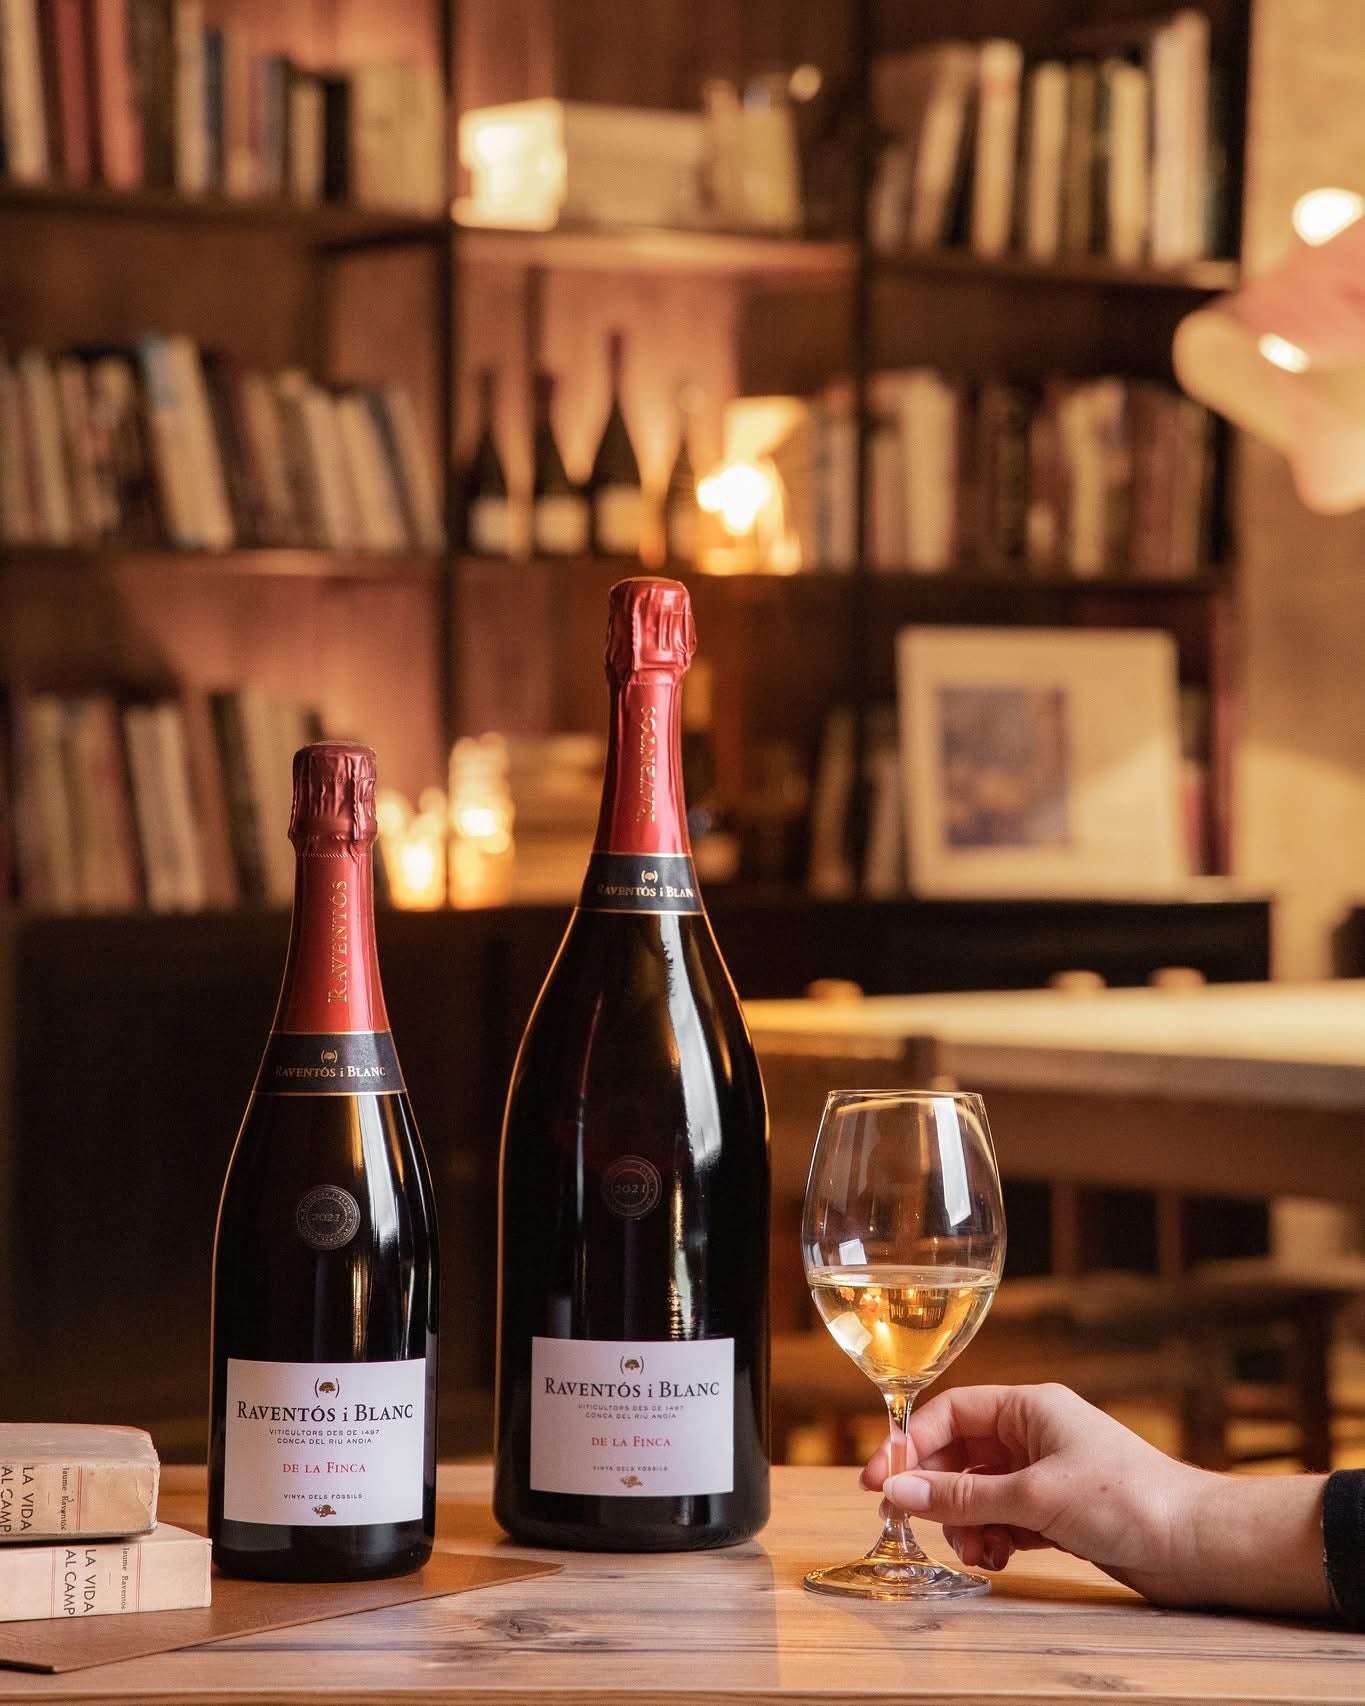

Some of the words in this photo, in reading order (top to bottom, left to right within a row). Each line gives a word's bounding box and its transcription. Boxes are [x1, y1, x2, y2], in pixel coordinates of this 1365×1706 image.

[659, 887, 664, 897] i
[327, 879, 348, 1003] RAVENTÓS
[339, 1067, 344, 1078] i
[347, 1065, 386, 1078] BLANC
[544, 1377, 641, 1398] RAVENTÓS
[647, 1384, 653, 1398] i
[660, 1381, 720, 1398] BLANC
[237, 1401, 336, 1422] RAVENTÓS
[342, 1407, 348, 1421] i
[354, 1403, 413, 1421] BLANC
[578, 1403, 630, 1411] VITICULTORS
[585, 1411, 613, 1420] CONCA
[269, 1429, 324, 1437] VITICULTORS
[276, 1437, 306, 1445] CONCA
[309, 1437, 325, 1445] DEL
[591, 1436, 608, 1447] DE
[612, 1437, 628, 1447] LA
[633, 1435, 671, 1447] FINCA
[0, 1466, 14, 1485] AL
[22, 1467, 35, 1486] LA
[282, 1463, 299, 1473] DE
[305, 1463, 320, 1473] LA
[326, 1461, 366, 1473] FINCA
[61, 1467, 70, 1491] Jaume
[0, 1488, 14, 1533] CAMP
[20, 1492, 35, 1531] VIDA
[65, 1549, 77, 1568] AL
[85, 1549, 97, 1568] LA
[121, 1547, 130, 1571] Jaume
[63, 1571, 77, 1616] CAMP
[83, 1574, 97, 1613] VIDA
[121, 1575, 129, 1610] Raventós
